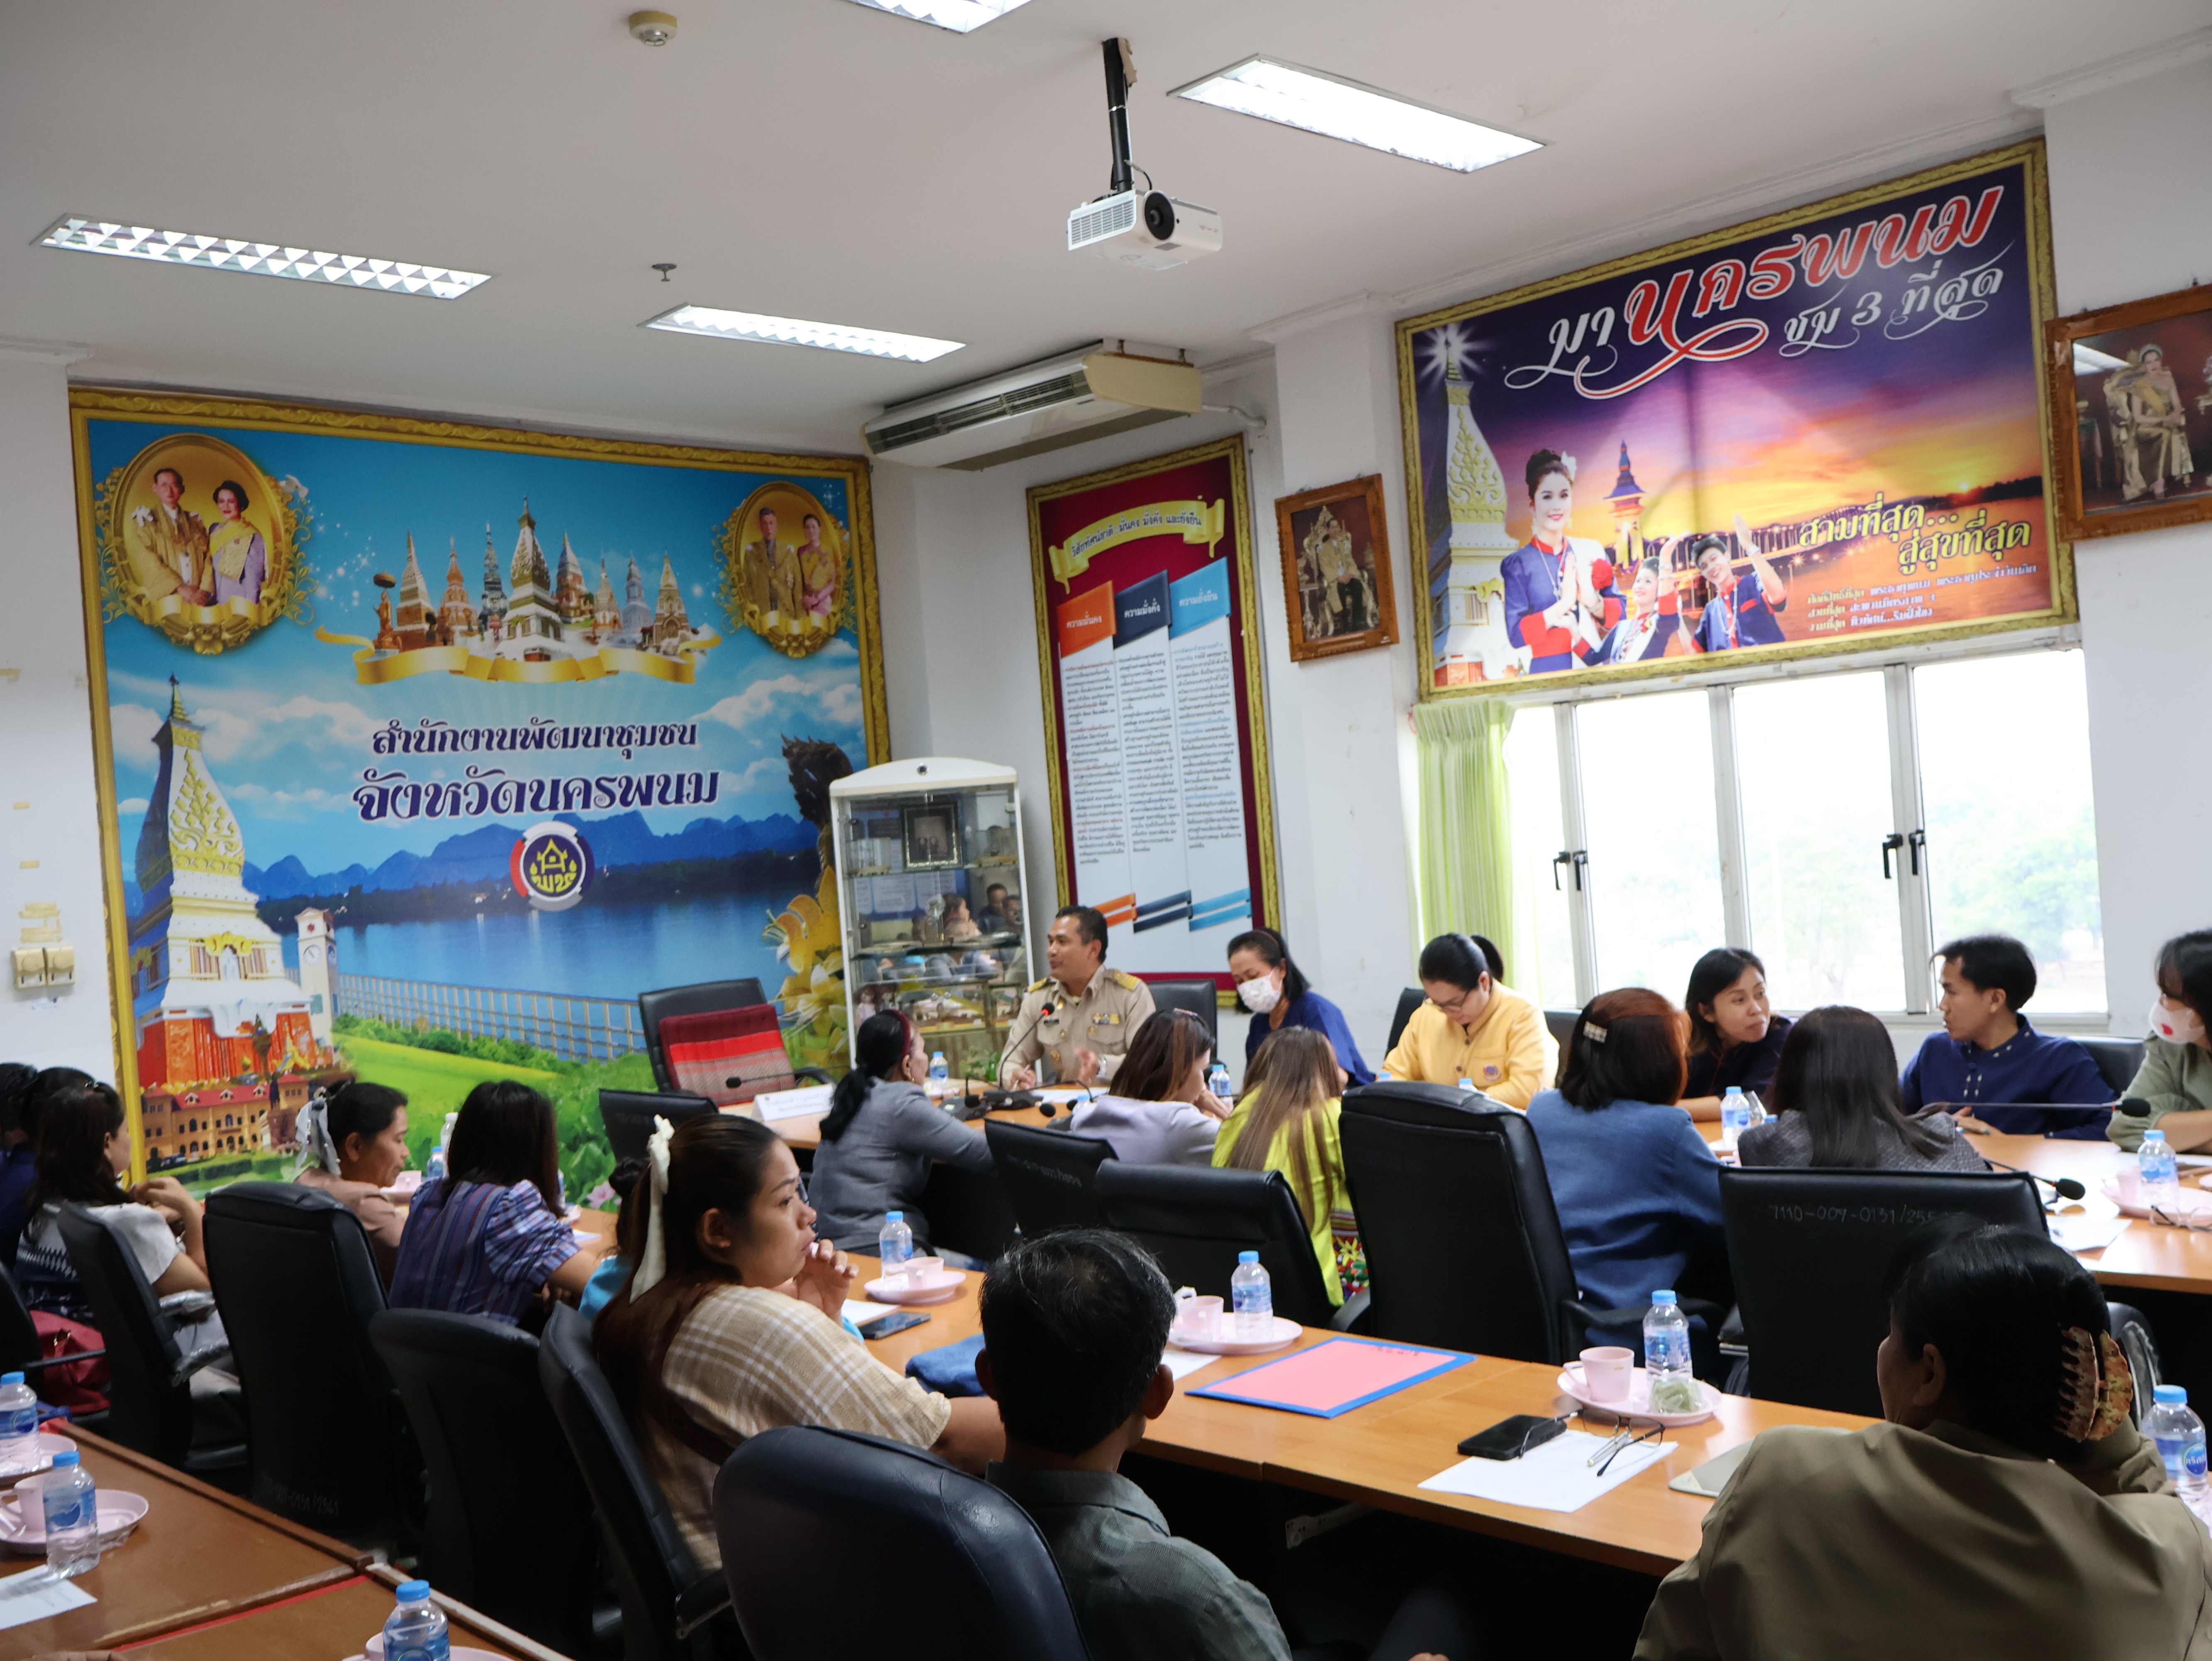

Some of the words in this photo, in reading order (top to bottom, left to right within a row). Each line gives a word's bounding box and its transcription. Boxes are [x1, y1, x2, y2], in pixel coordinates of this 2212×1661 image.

[1851, 291, 1884, 326] 3
[1883, 239, 2016, 341] ที่สุด
[1898, 509, 2031, 575] สู่สุขที่สุด
[1067, 611, 1102, 628] ความมั่นคง
[1124, 598, 1160, 618] ความมั่งคั่ง
[372, 716, 698, 760] สำนักงานพัฒนาชุมชน
[352, 764, 721, 821] จังหวัดนครพนม
